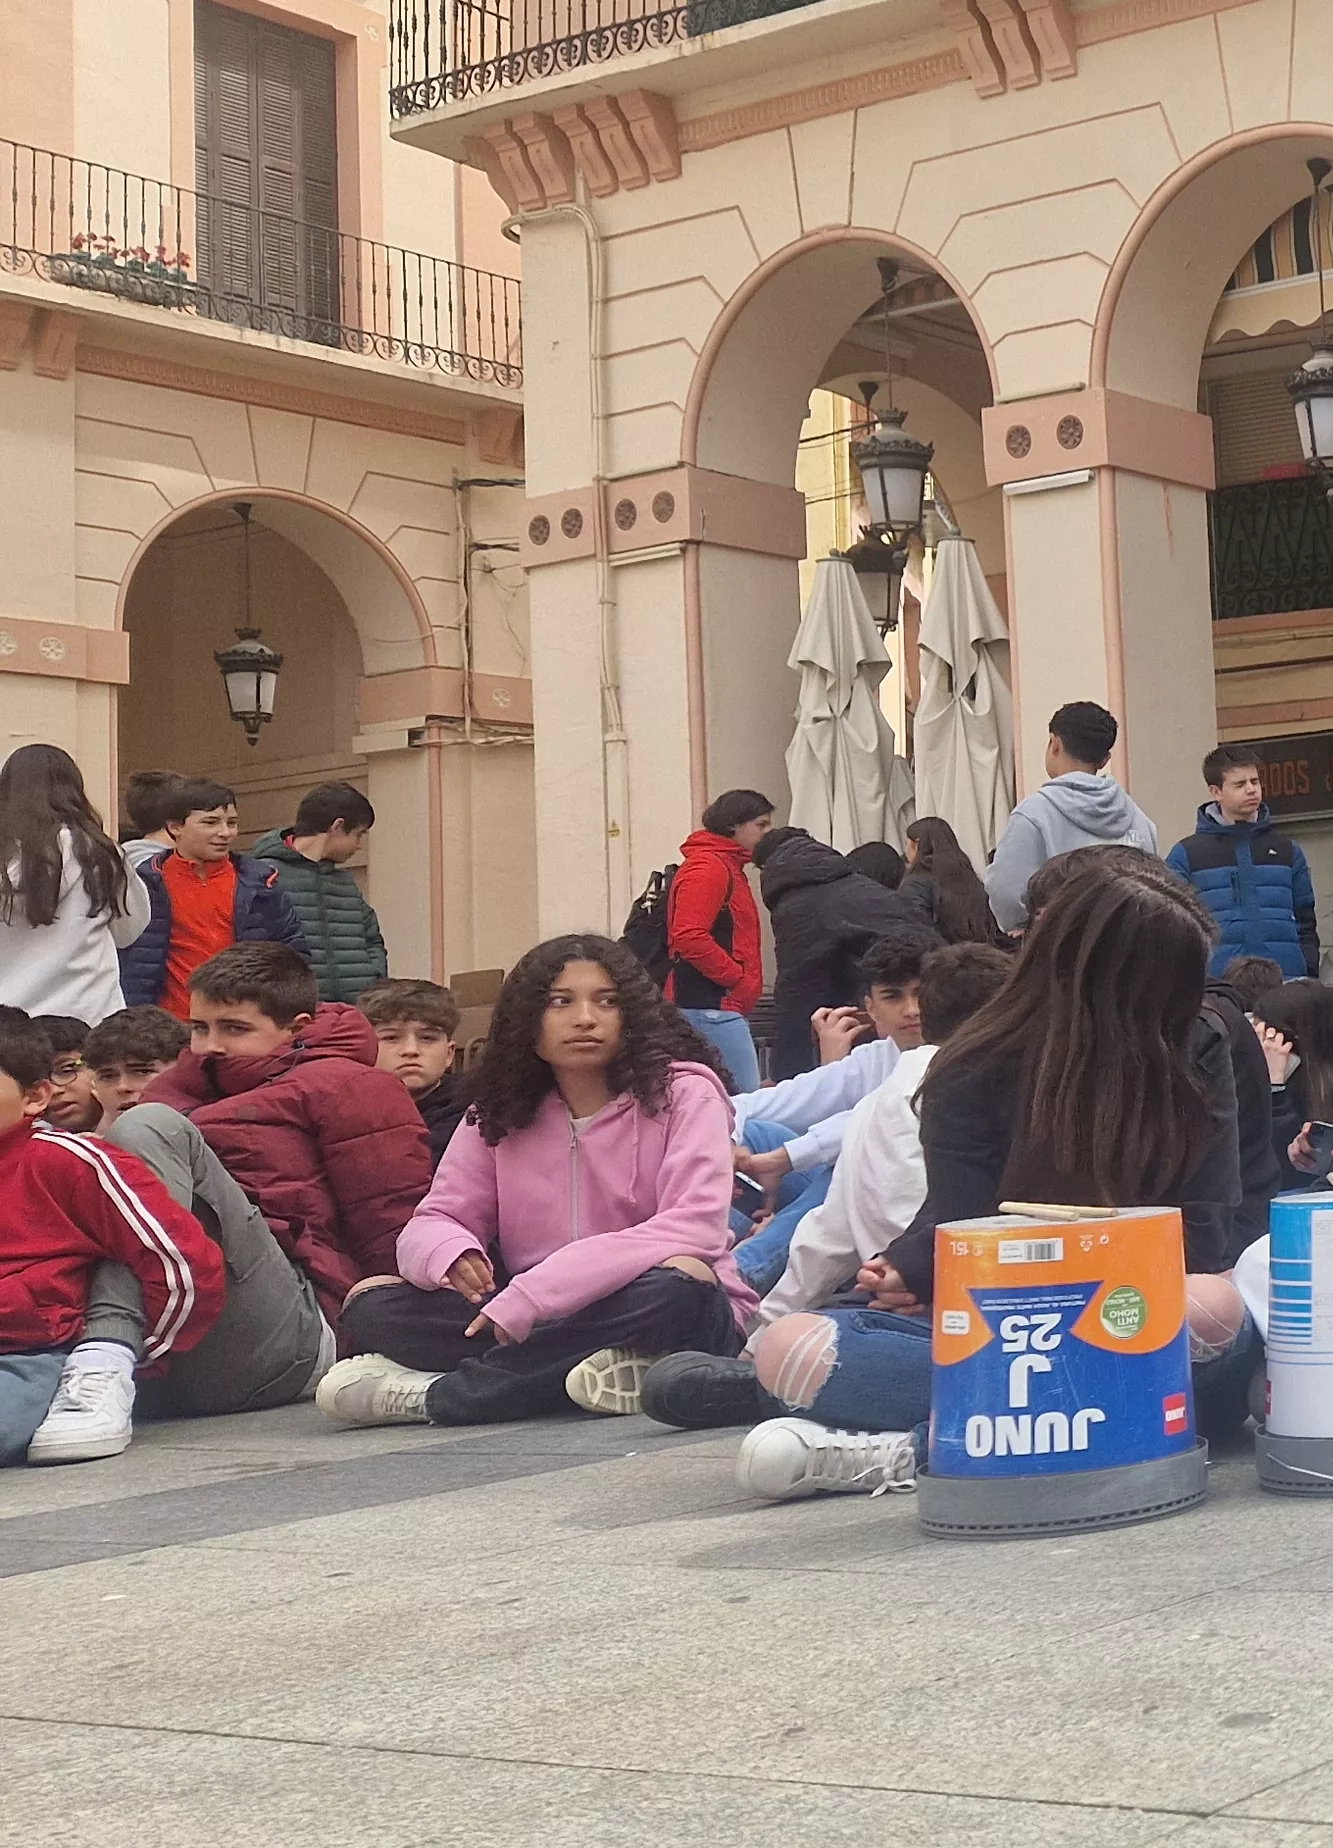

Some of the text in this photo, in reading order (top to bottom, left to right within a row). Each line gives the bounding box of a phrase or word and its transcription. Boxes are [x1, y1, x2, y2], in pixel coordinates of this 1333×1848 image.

[950, 1241, 969, 1256] 15L
[1109, 1307, 1139, 1318] MOHO
[1117, 1315, 1140, 1325] ANTI
[1000, 1312, 1063, 1354] 25
[1009, 1354, 1053, 1409] J
[965, 1406, 1106, 1458] JUNO
